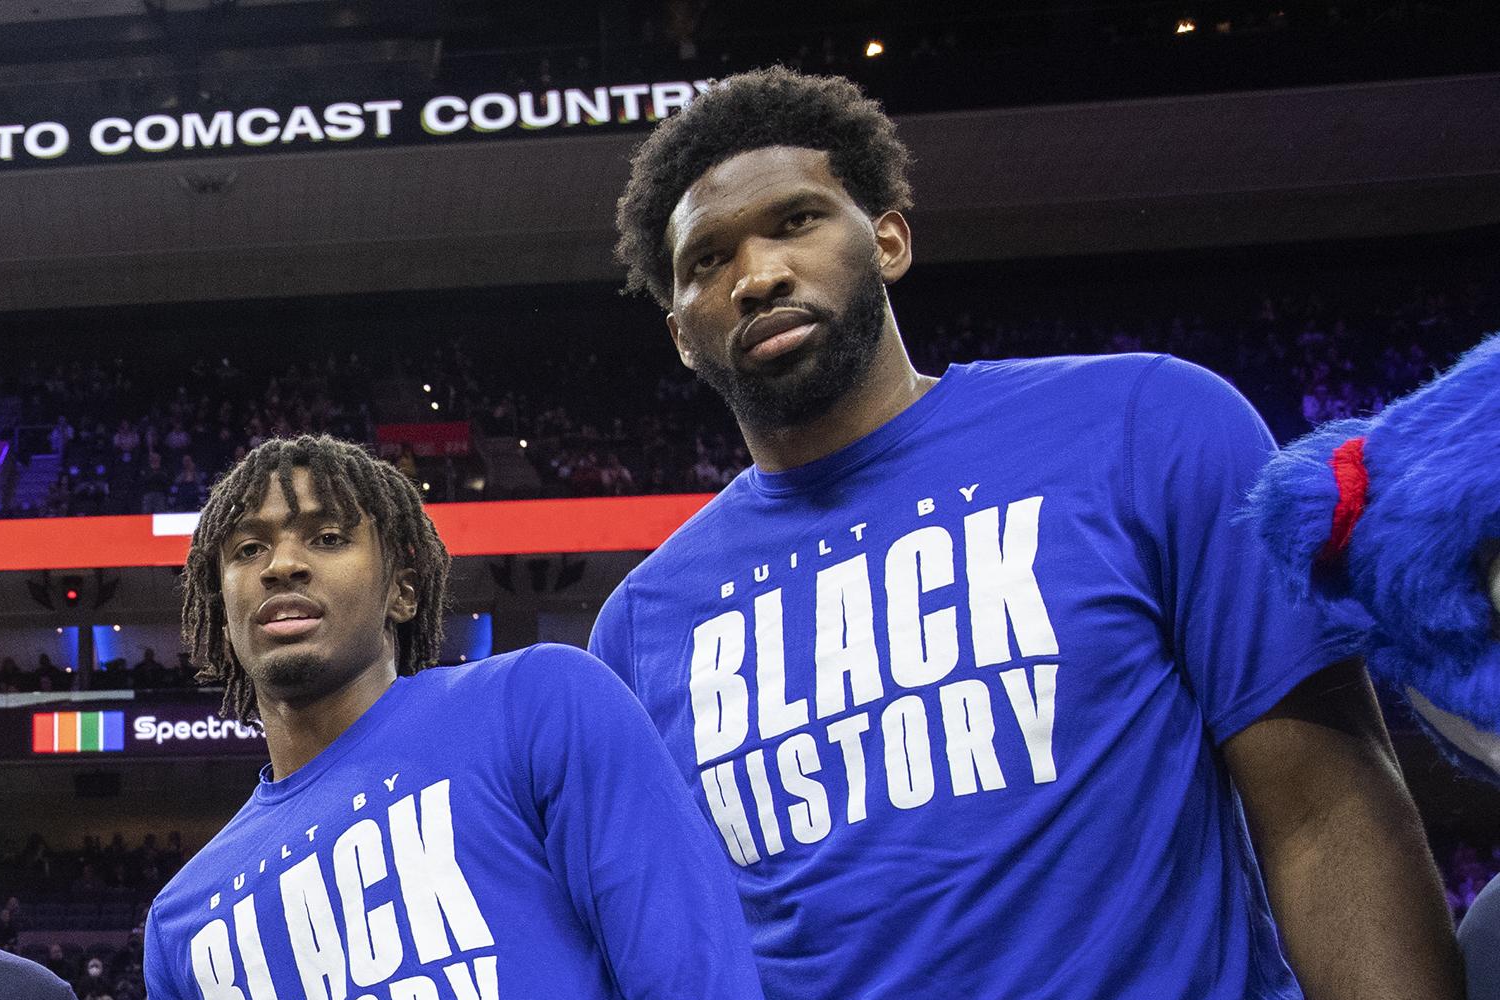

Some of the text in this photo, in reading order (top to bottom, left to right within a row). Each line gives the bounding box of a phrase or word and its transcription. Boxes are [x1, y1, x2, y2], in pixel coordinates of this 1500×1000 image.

[89, 102, 404, 155] COMCAST
[719, 484, 980, 601] BUILT BY
[690, 496, 1060, 767] BLACK
[700, 664, 1061, 868] HISTORY
[210, 774, 400, 911] BUILT BY
